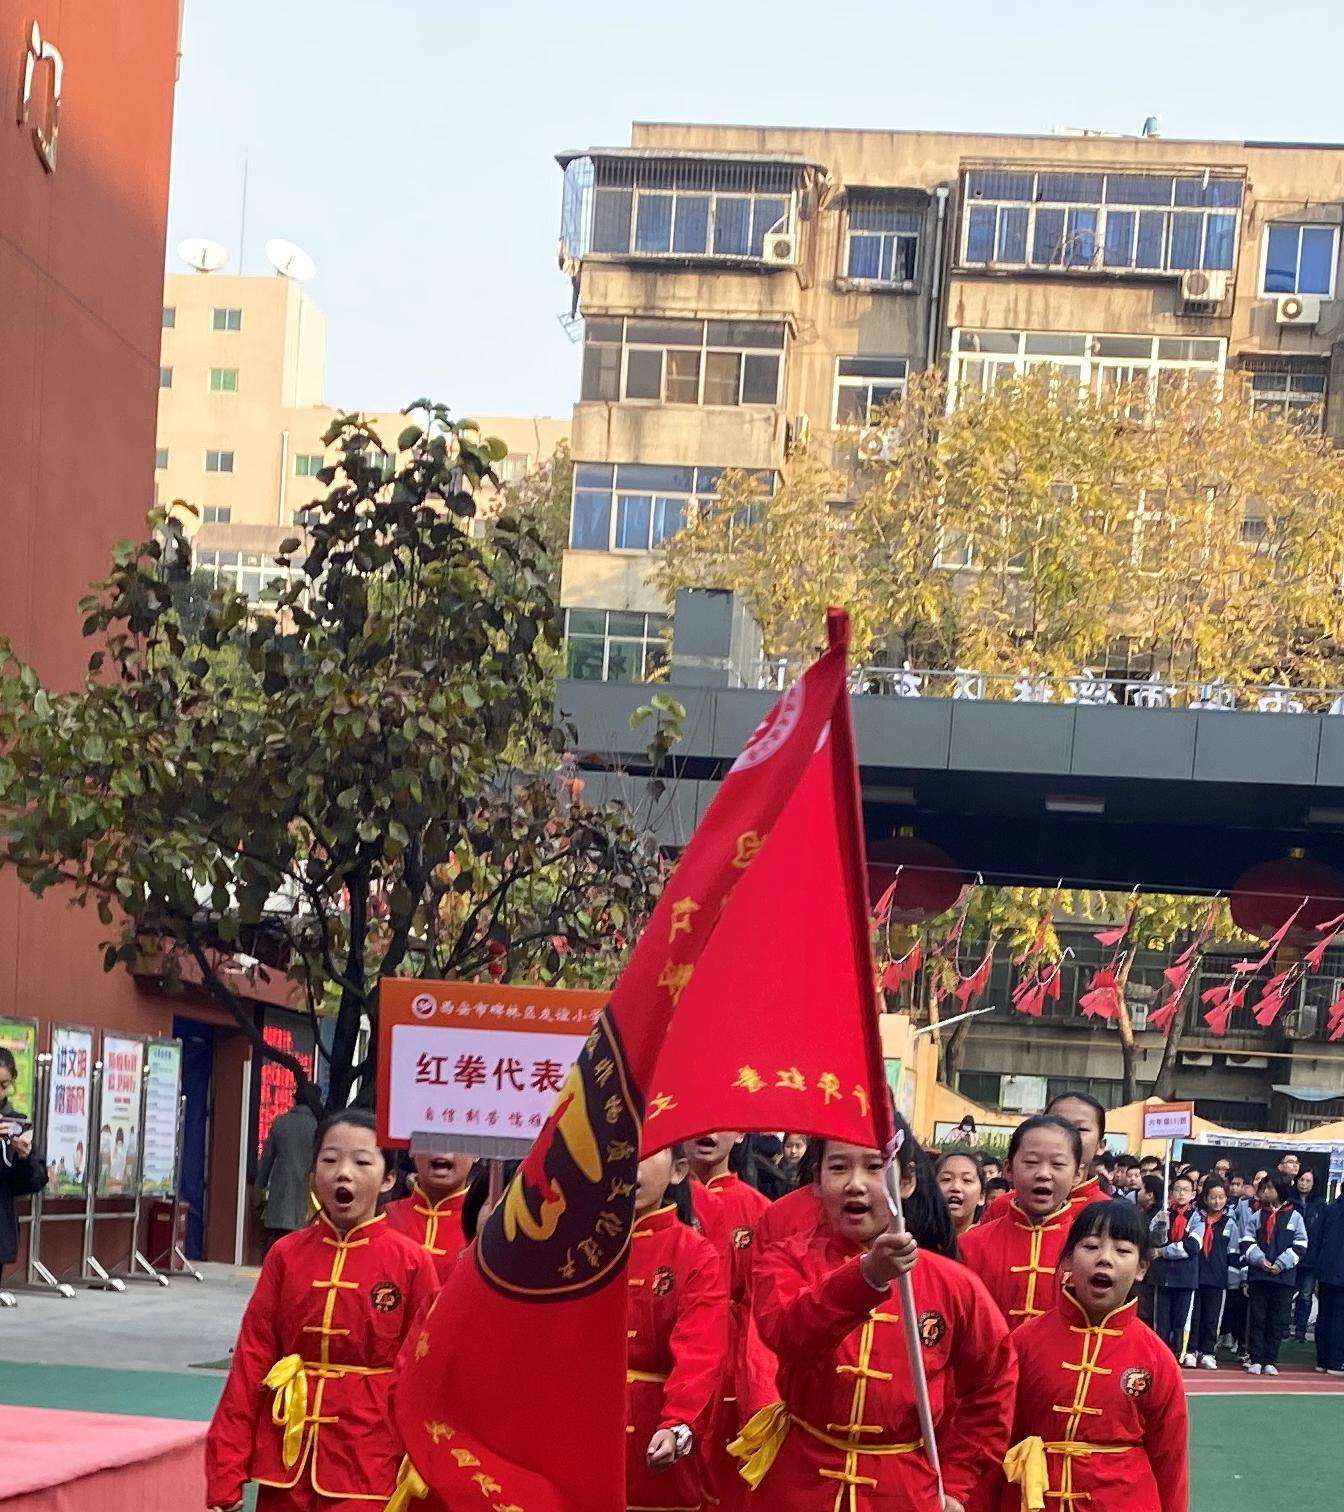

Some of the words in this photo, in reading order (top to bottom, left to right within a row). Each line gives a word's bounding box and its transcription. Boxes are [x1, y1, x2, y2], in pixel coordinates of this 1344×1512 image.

[57, 1049, 87, 1078] 讲文明
[415, 1052, 565, 1093] 红拳代表
